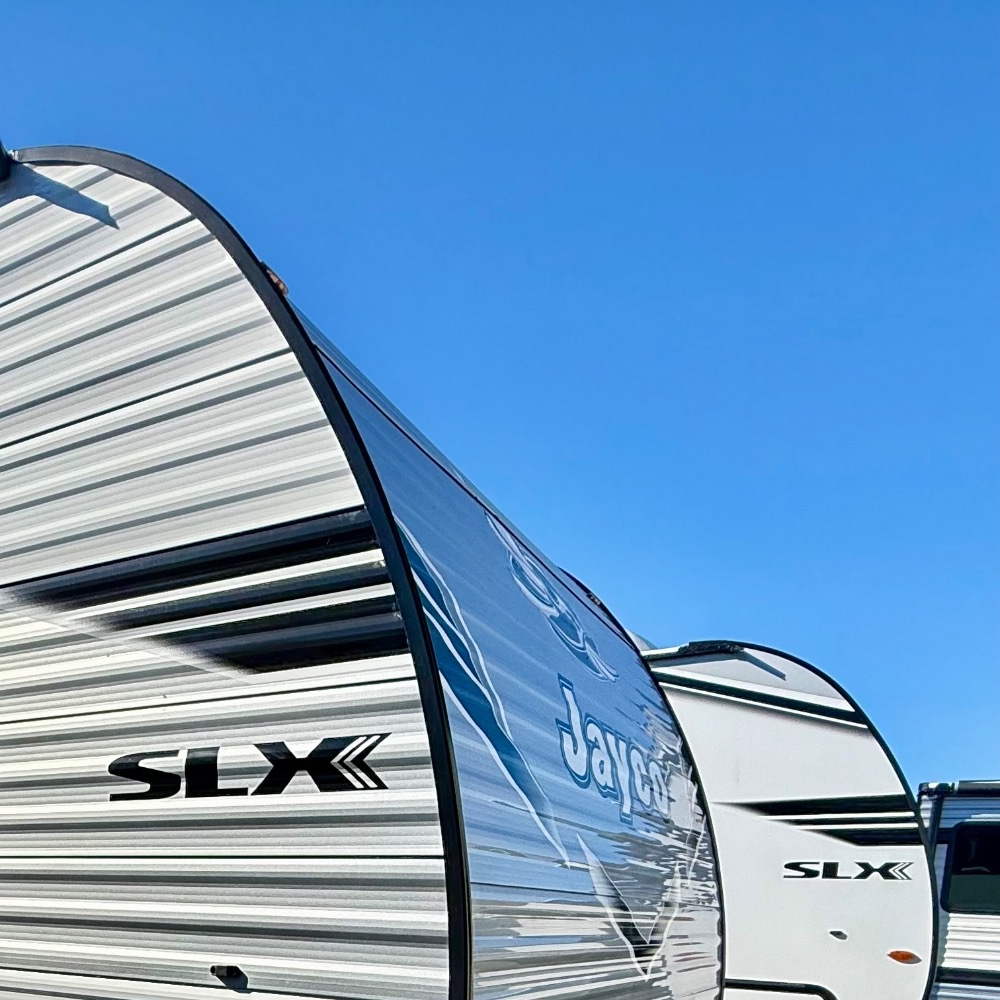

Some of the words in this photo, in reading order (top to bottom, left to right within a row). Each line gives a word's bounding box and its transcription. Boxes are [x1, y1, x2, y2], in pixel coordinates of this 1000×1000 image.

[108, 733, 392, 801] SLX
[555, 673, 672, 825] Jayco
[783, 861, 915, 881] SLX
